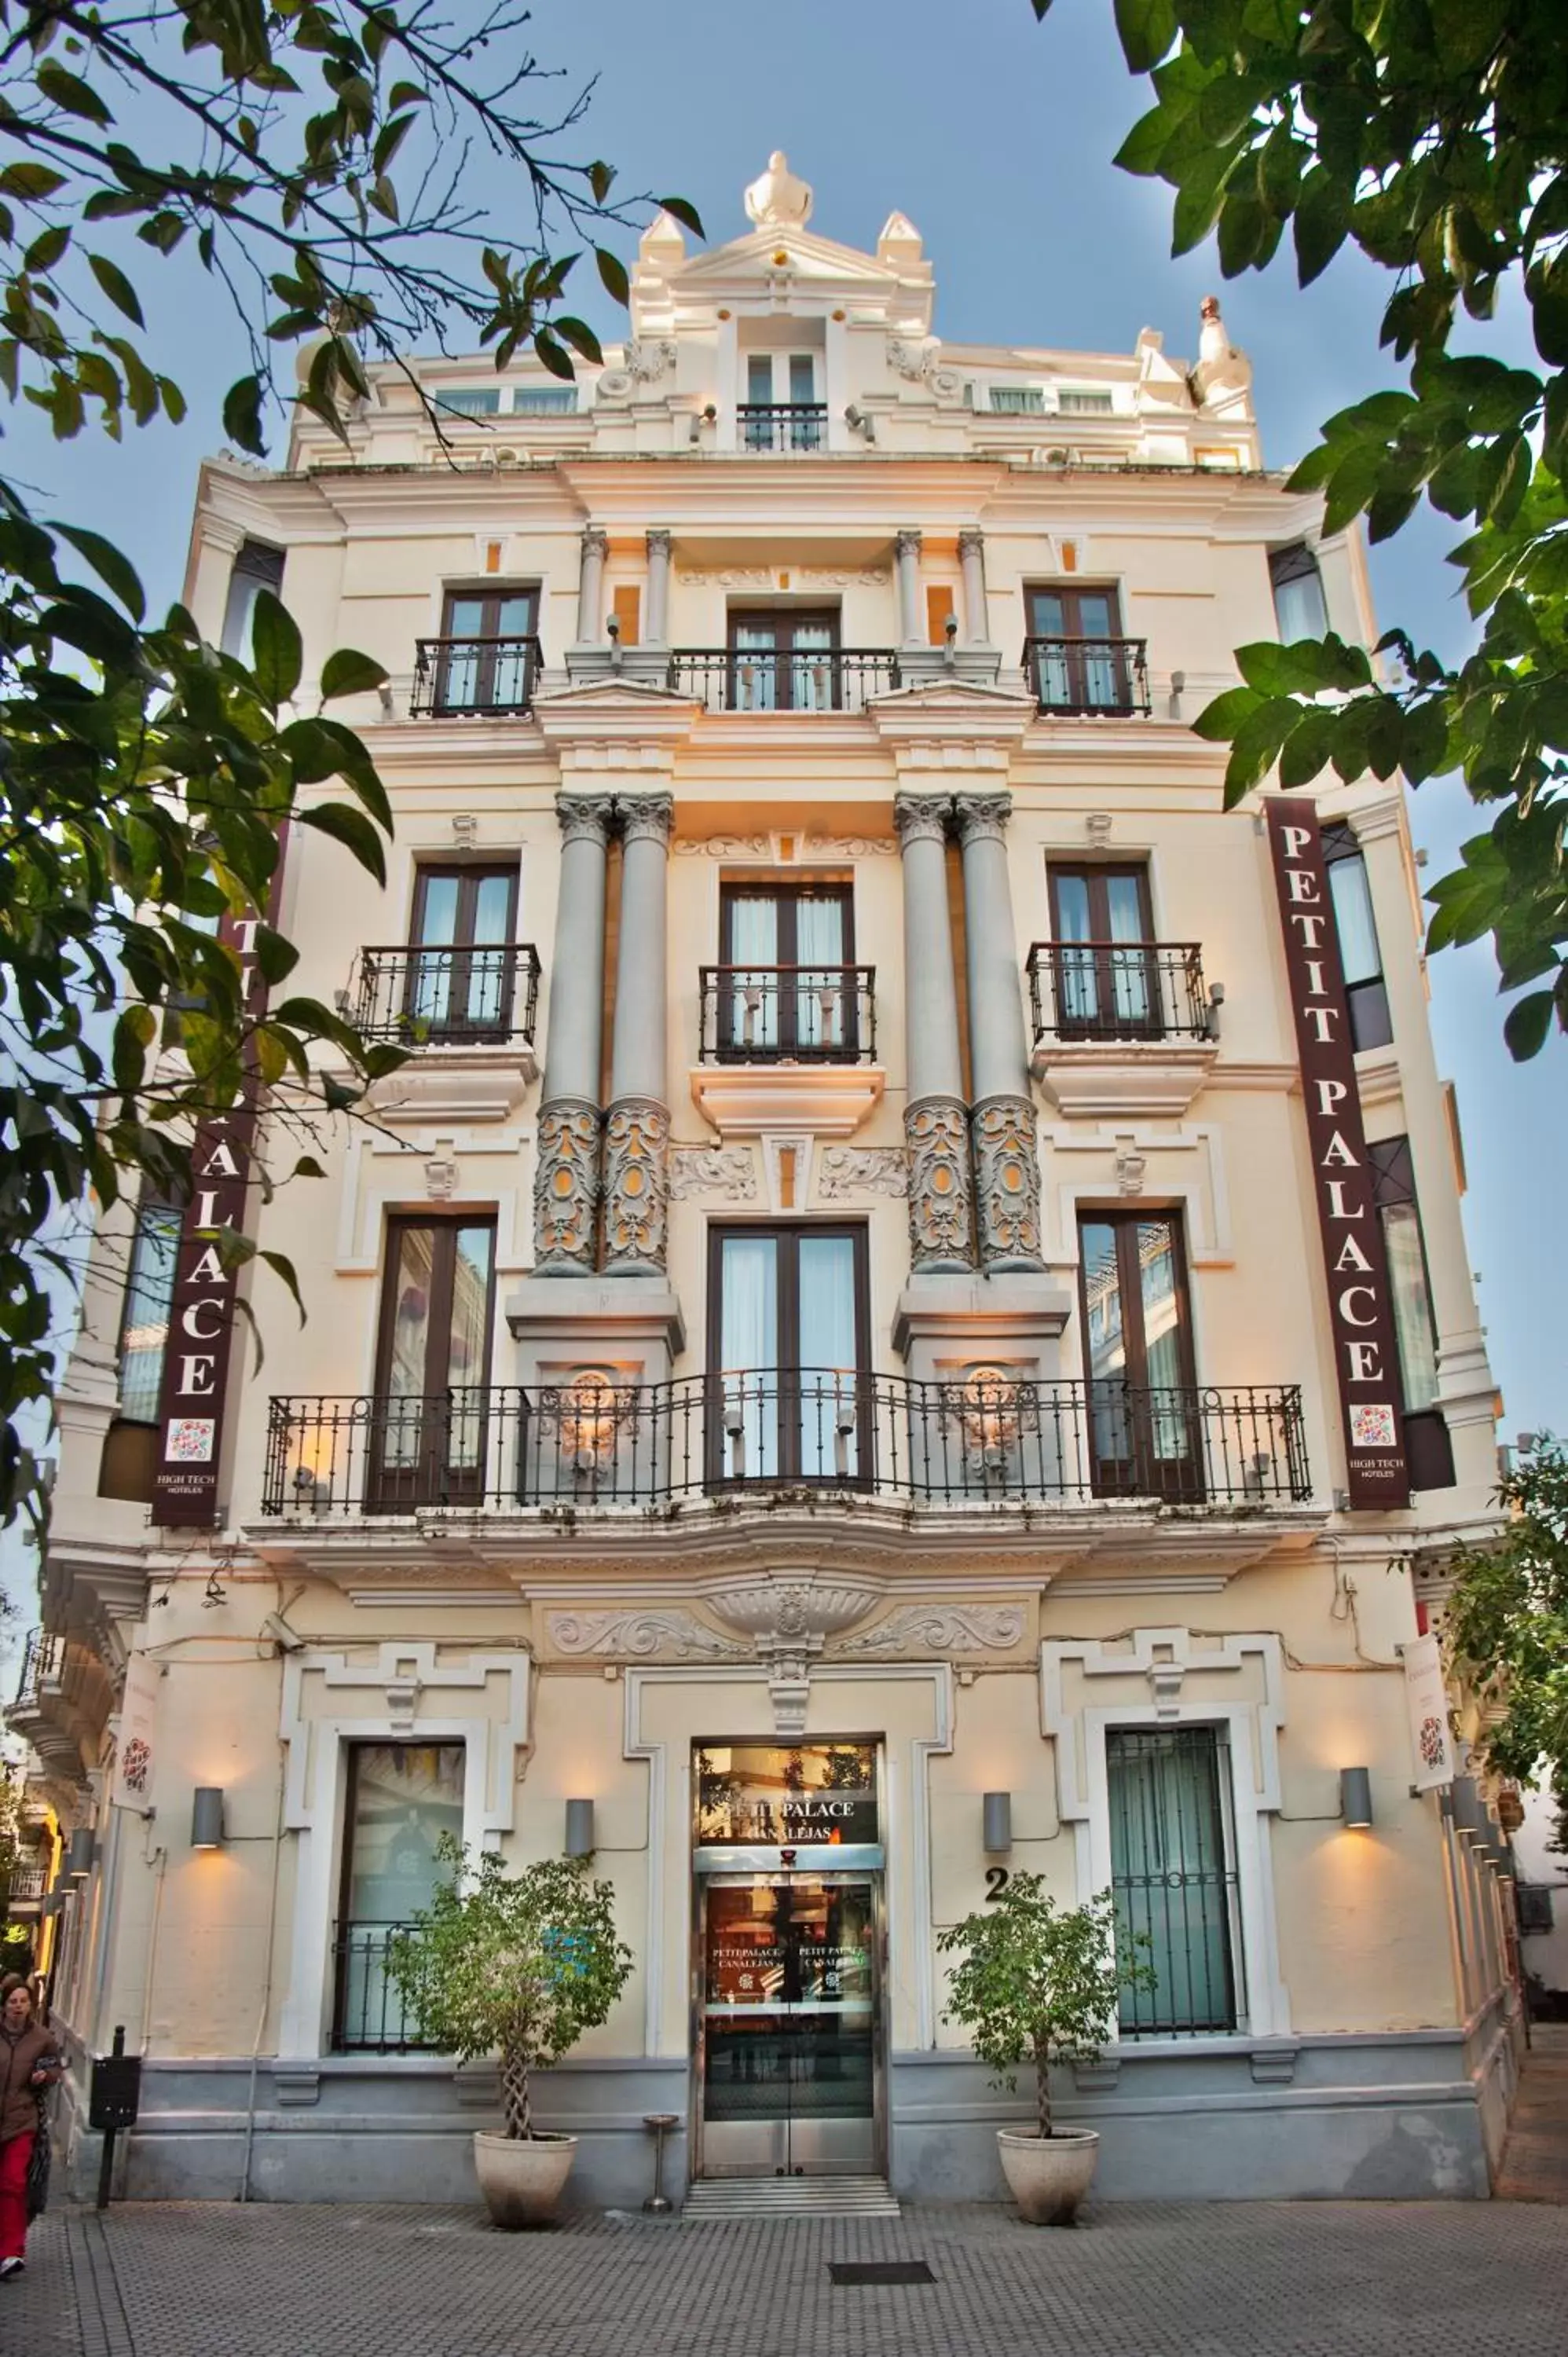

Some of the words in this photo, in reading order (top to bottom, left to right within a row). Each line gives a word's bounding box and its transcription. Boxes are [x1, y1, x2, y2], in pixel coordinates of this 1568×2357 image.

[1280, 826, 1339, 1043] PETIT
[1313, 1080, 1384, 1382] PALACE
[1350, 1459, 1375, 1468] HIGH
[1376, 1458, 1404, 1468] TECH
[157, 1475, 185, 1484] HIGH
[188, 1475, 214, 1484] TECH
[726, 1802, 776, 1817] ETIT
[782, 1802, 855, 1817] PALACE
[746, 1827, 831, 1839] ANLEJAS
[985, 1867, 1009, 1902] 2
